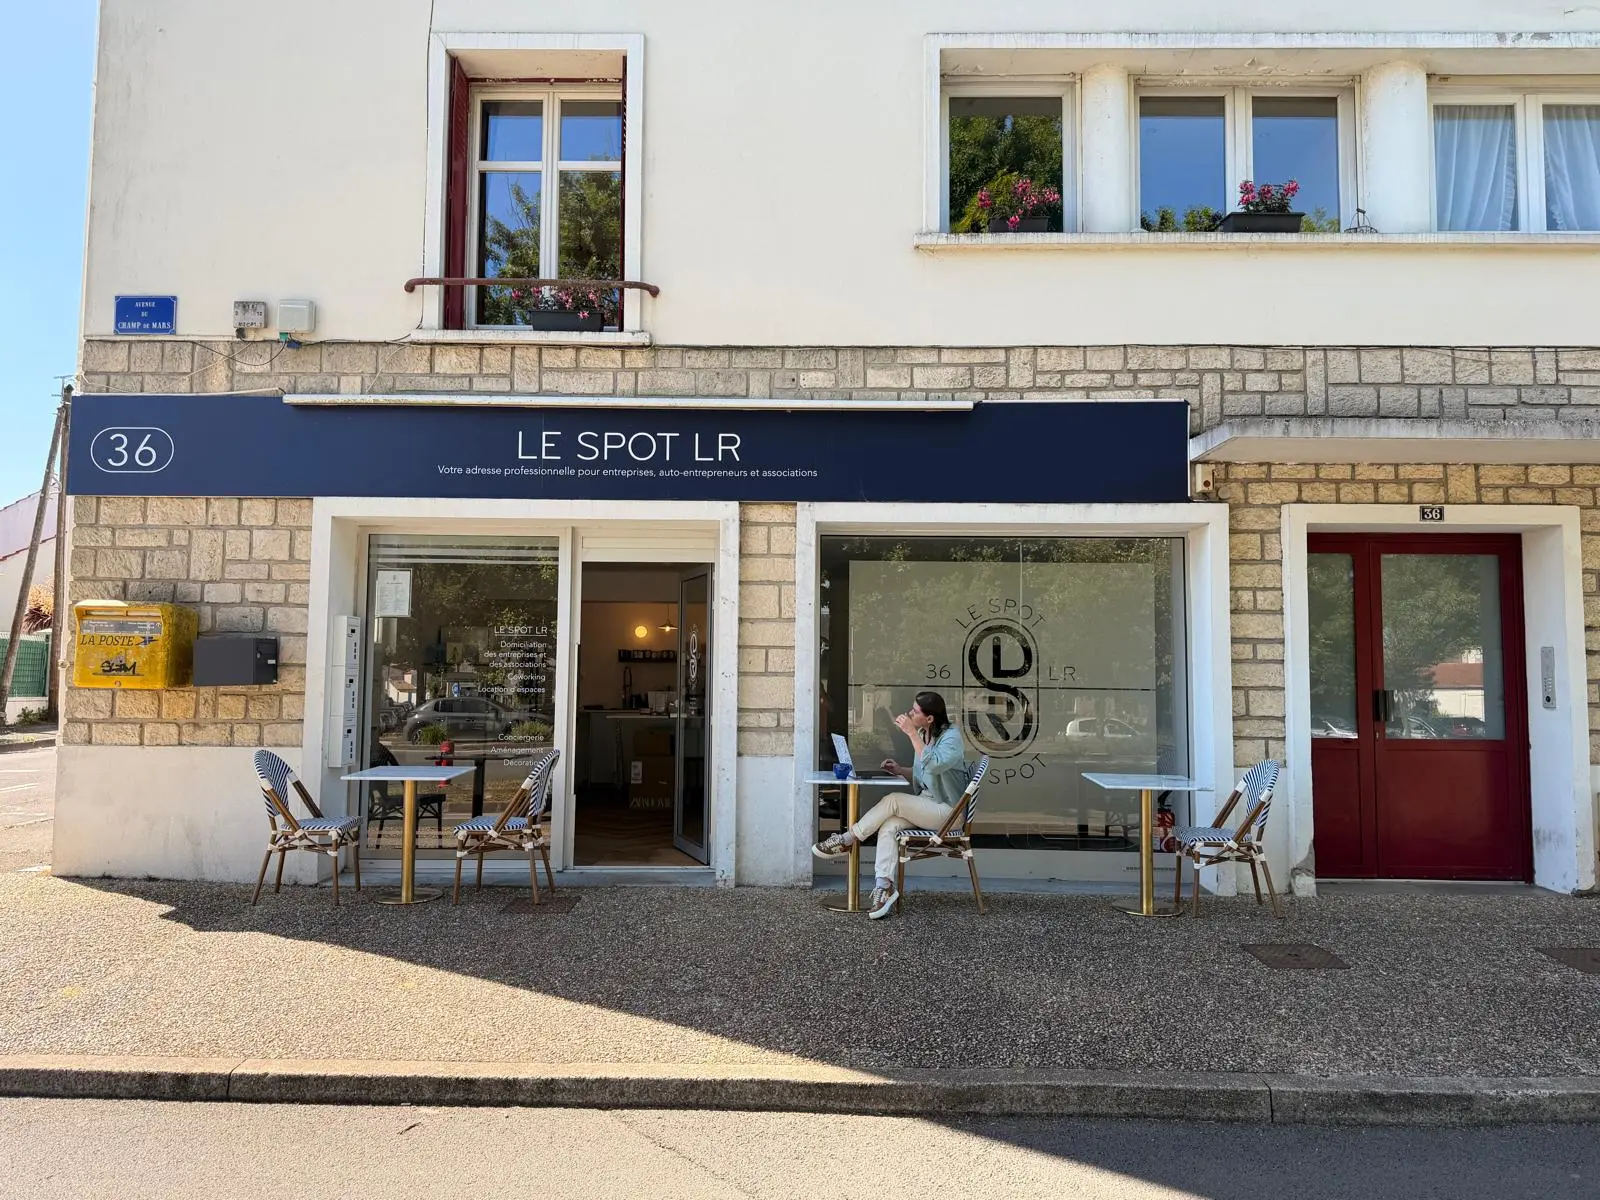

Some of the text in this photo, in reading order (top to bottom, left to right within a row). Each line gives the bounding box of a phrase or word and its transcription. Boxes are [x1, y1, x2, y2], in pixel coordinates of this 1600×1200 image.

[117, 321, 142, 329] CHAMP
[151, 321, 171, 329] MARS
[107, 433, 157, 467] 36
[517, 430, 741, 462] LE SPOT LR
[437, 464, 818, 479] Votre adresse professionnelle pour entreprises, auto-entrepreneurs et associations
[1424, 508, 1441, 519] 36
[954, 598, 1047, 630] LE SPOT
[494, 626, 548, 634] LE SPOT LR
[80, 634, 135, 647] LA POSTE
[498, 651, 538, 660] entreprises
[926, 663, 951, 680] 36
[1049, 666, 1076, 681] LR
[477, 685, 509, 694] Location
[498, 733, 545, 742] Conciergerie
[490, 745, 544, 755] Aménagement
[988, 753, 1047, 785] SPOT
